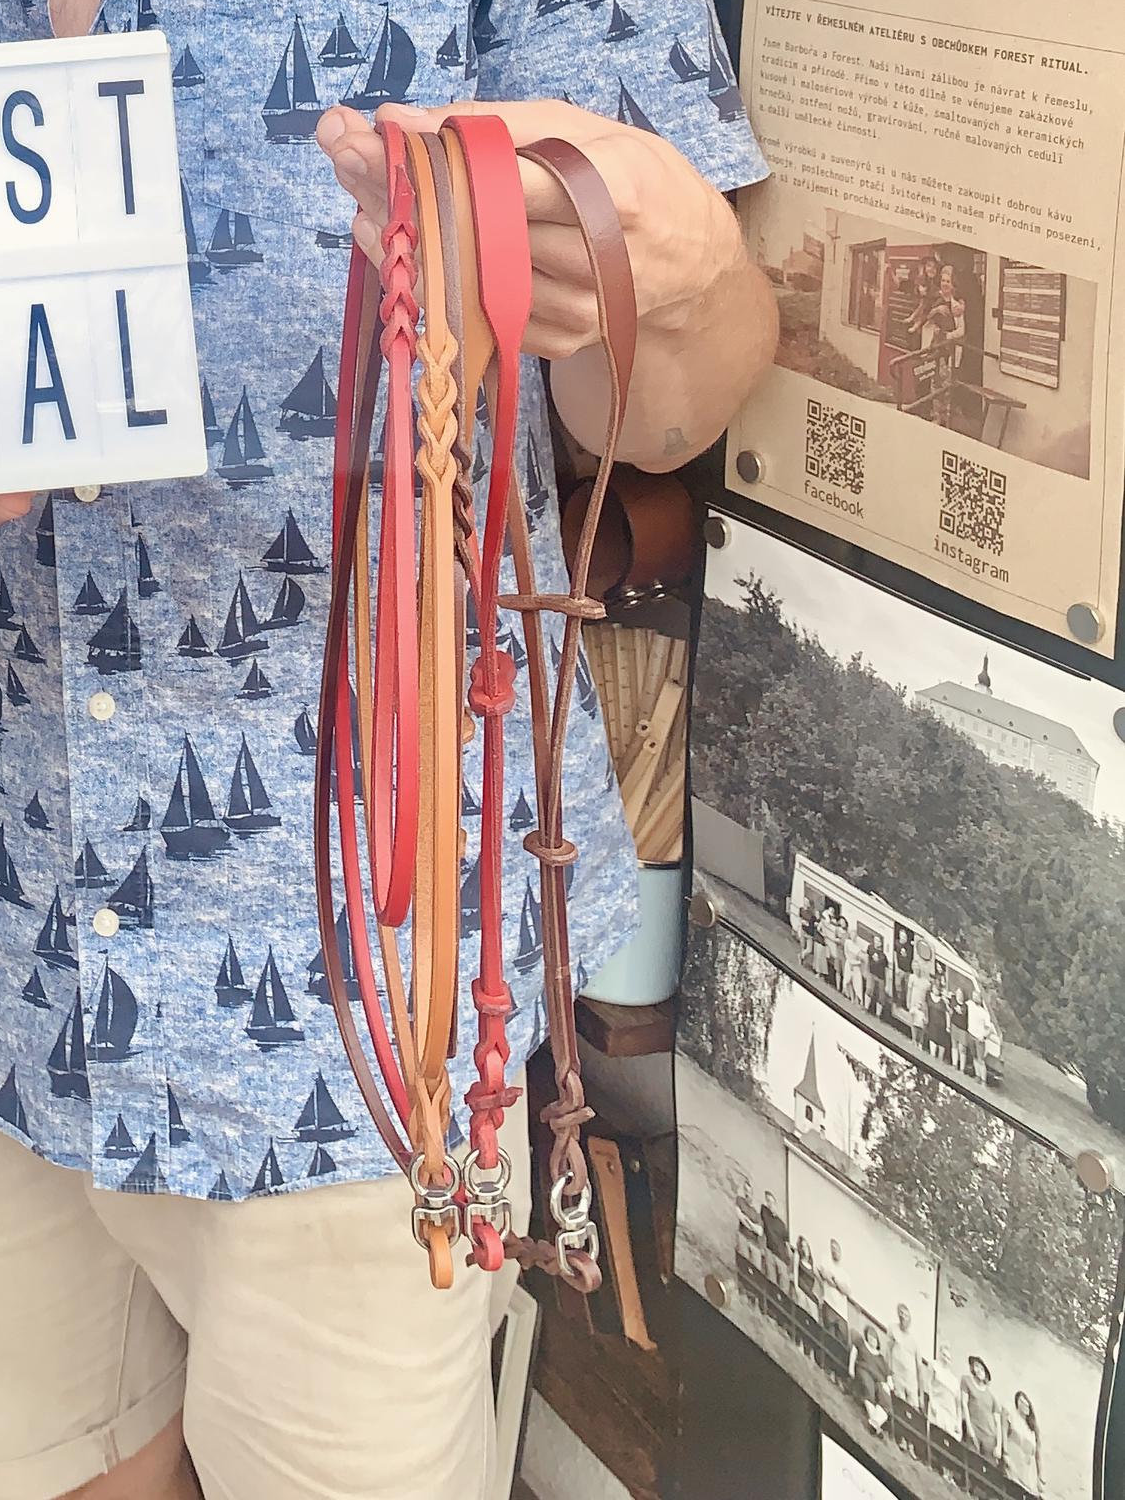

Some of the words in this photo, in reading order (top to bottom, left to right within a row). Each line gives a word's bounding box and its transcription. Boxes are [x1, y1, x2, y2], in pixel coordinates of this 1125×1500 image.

[765, 5, 801, 21] VÍTEJTE
[806, 13, 812, 23] V
[817, 13, 864, 33] ŘEMESLNÉM
[869, 26, 915, 43] ATELIÉRU
[920, 35, 926, 45] S
[932, 37, 988, 57] OBCHŮDKEM
[994, 49, 1035, 65] FOREST
[1041, 57, 1088, 75] RITUAL.
[931, 72, 969, 89] zálibou
[974, 80, 985, 93] je
[990, 84, 1026, 100] návrat
[1032, 91, 1038, 102] k
[1044, 94, 1093, 115] řemeslu,
[952, 96, 962, 106] se
[968, 99, 1013, 116] věnujeme
[1019, 110, 1074, 128] zakázkové
[966, 134, 1022, 155] malovaných
[1006, 125, 1011, 134] a
[1018, 126, 1084, 149] keramických
[942, 200, 952, 210] na
[958, 187, 1001, 205] zakoupit
[1007, 199, 1042, 215] dobrou
[1047, 208, 1072, 223] kávu
[804, 479, 864, 519] facebook
[934, 534, 1009, 583] instagram
